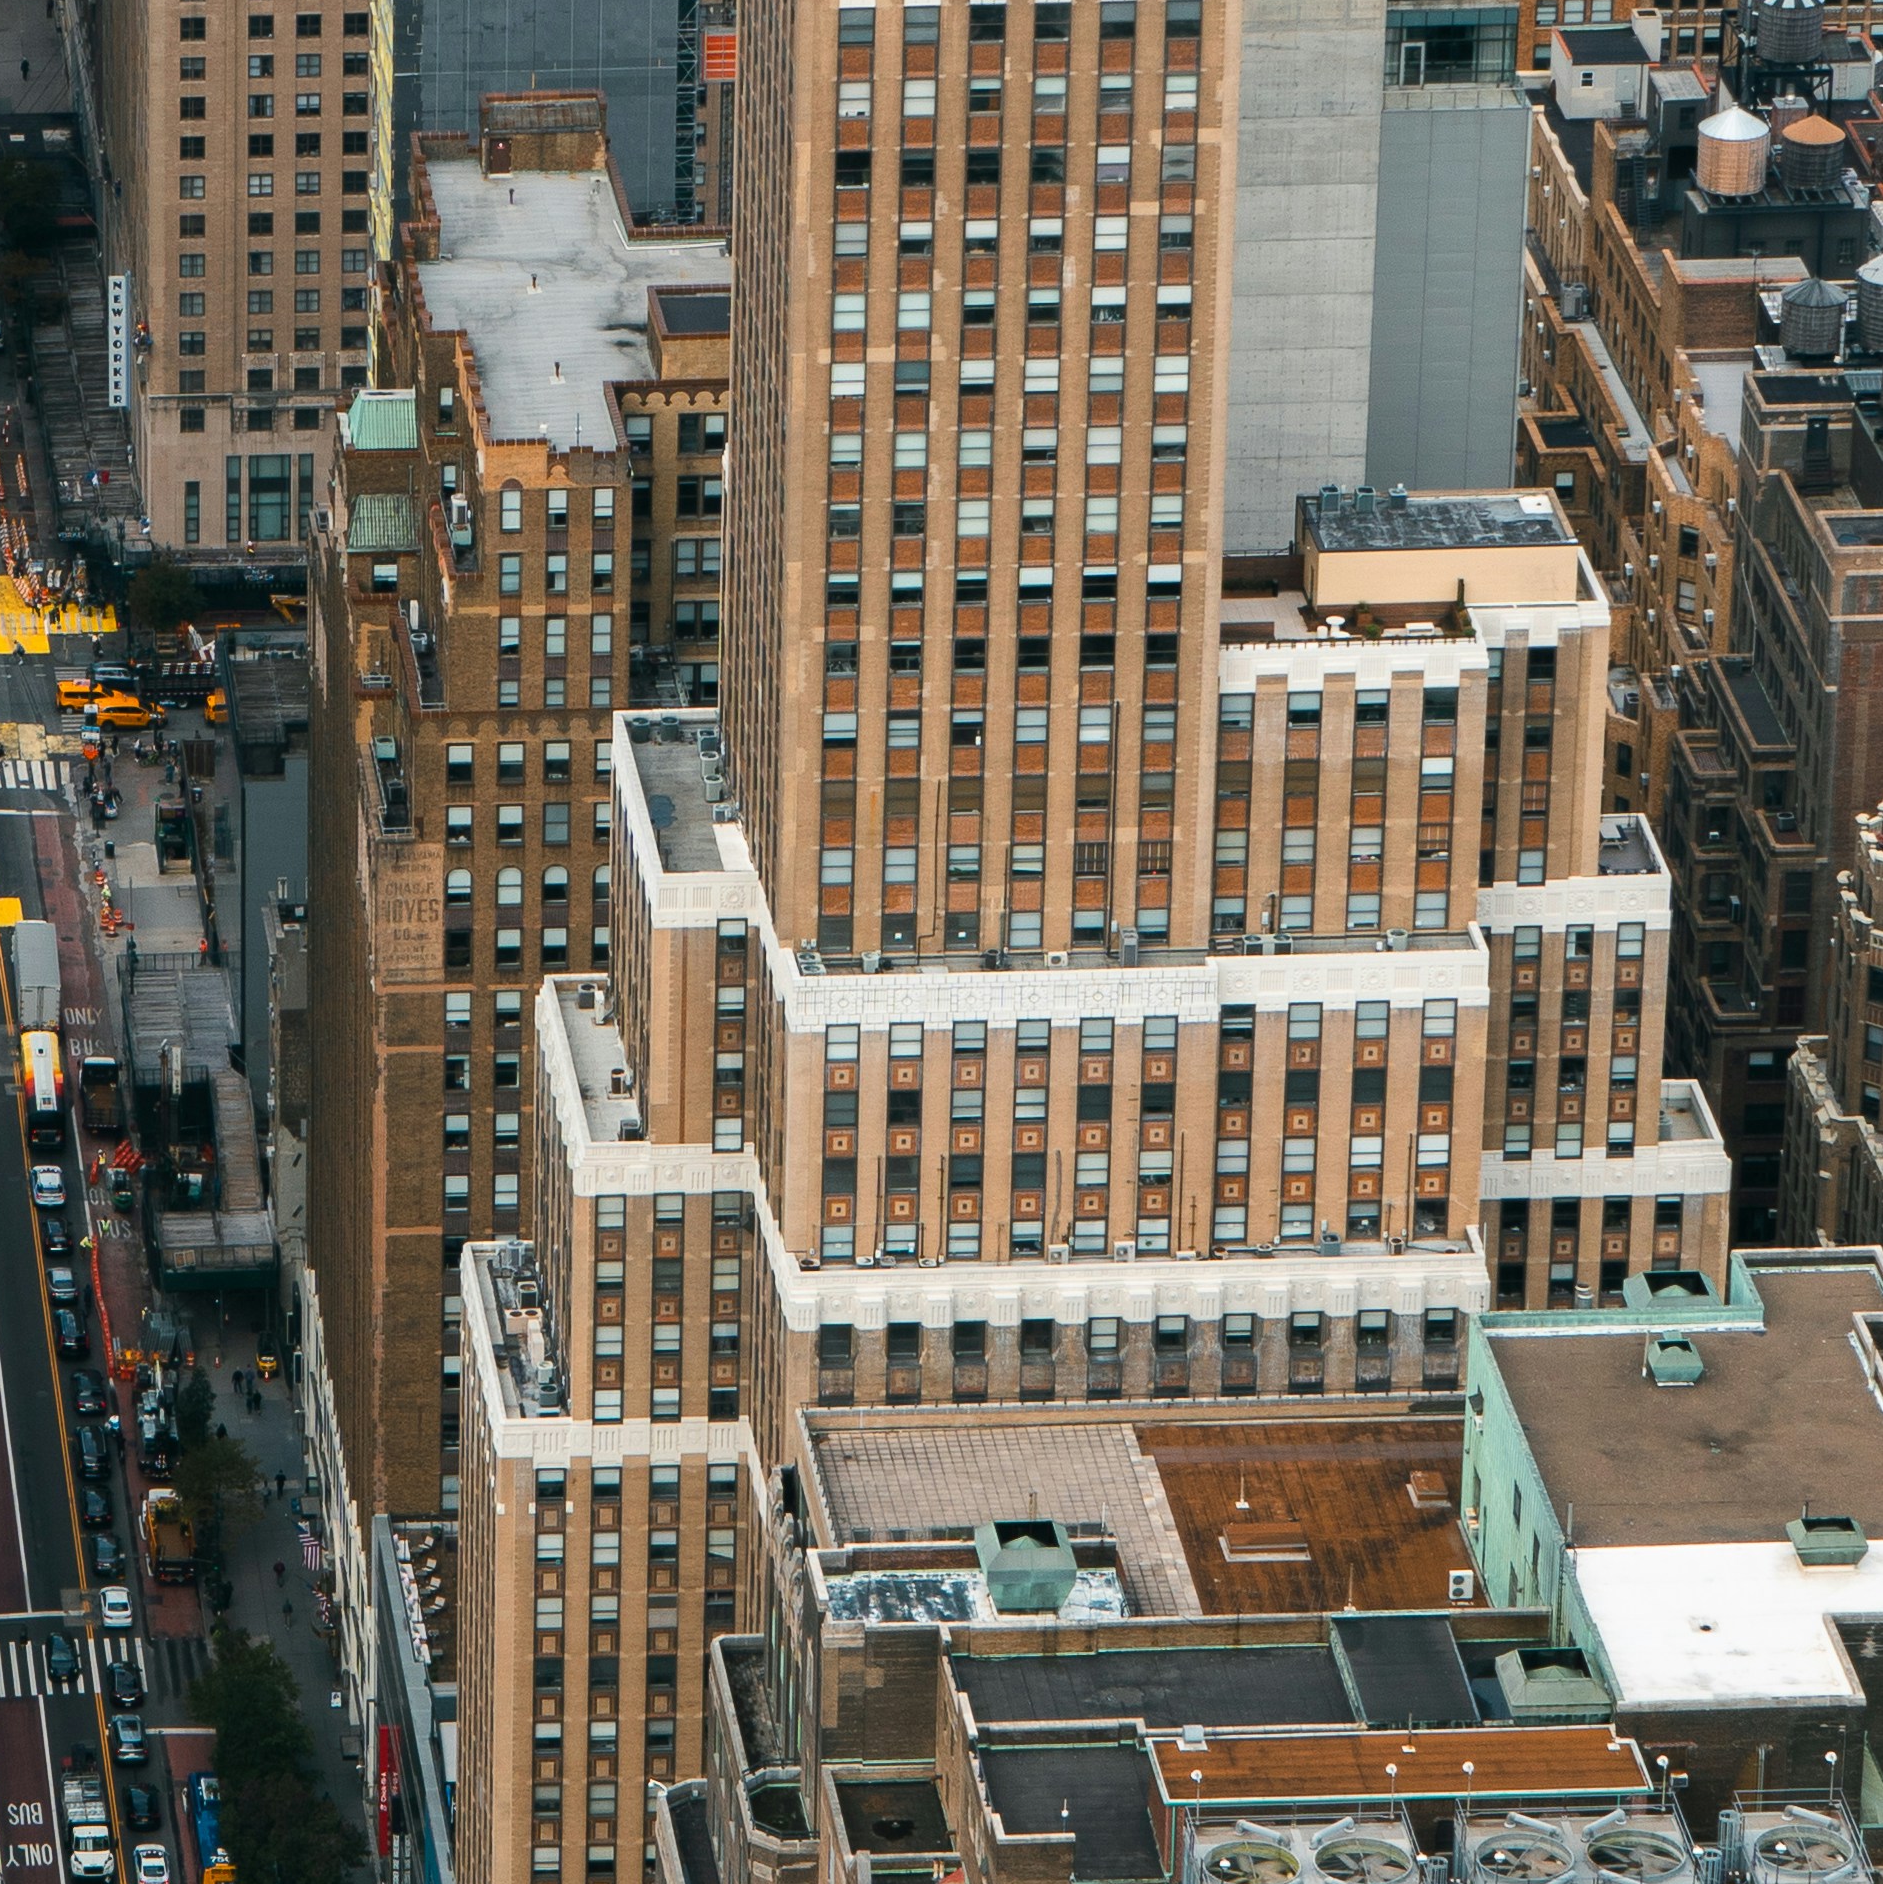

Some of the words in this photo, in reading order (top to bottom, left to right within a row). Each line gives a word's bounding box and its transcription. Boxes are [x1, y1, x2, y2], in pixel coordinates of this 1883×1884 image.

[111, 281, 123, 317] NEW
[112, 325, 124, 404] YORKER
[64, 1007, 103, 1025] ONLY
[69, 1038, 105, 1056] BUS
[7, 1802, 43, 1825] BUS
[6, 1842, 53, 1867] ONLY
